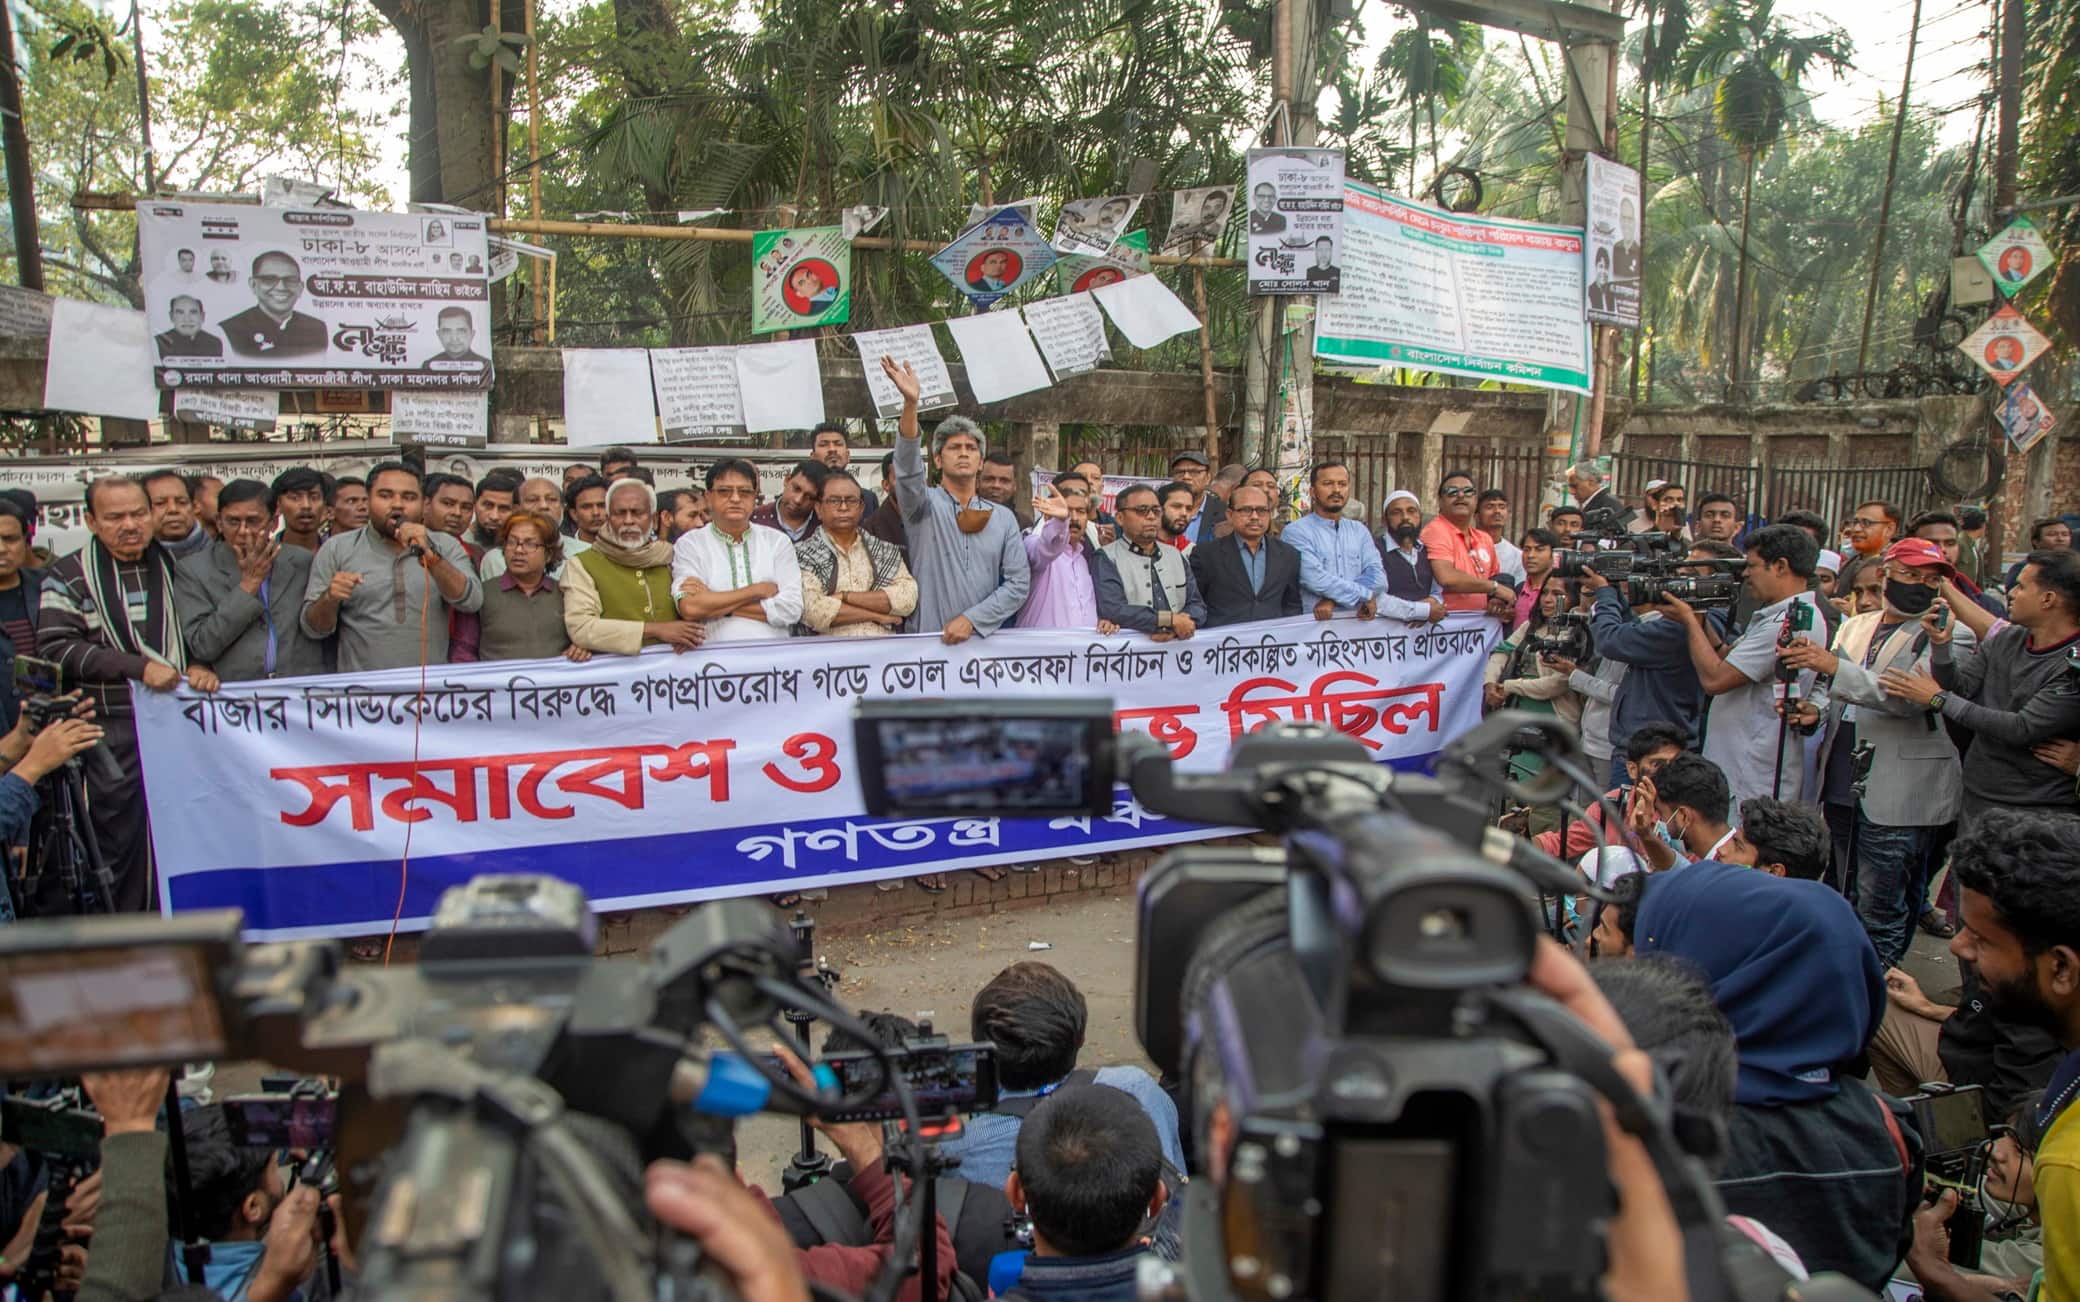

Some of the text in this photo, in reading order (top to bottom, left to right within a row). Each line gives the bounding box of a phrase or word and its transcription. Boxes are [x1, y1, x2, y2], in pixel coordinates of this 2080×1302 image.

[301, 238, 421, 258] ঢাকা-৮ আসনে
[364, 278, 418, 297] বাহাউদ্দিন
[420, 279, 451, 297] নাছিম
[454, 285, 483, 297] ভাইকে
[1407, 349, 1542, 377] বাংলাদেশ নির্বাচন কমিশন
[184, 371, 214, 385] রমনা
[217, 372, 241, 385] থানা
[244, 370, 292, 386] আওয়ামী
[380, 374, 404, 385] ঢাকা
[407, 374, 449, 386] মহানগর
[452, 373, 482, 386] দক্ষিণ
[177, 692, 291, 735] বাজার
[301, 680, 496, 732] সিন্ডিকেটের
[506, 675, 619, 721] বিরুদ্ধে
[631, 661, 802, 714] গণপ্রতিরোধ
[882, 656, 949, 694] তোল
[959, 649, 1078, 690] একতরফা
[1084, 640, 1169, 684] নির্বাচন
[1175, 650, 1194, 676] ও
[1203, 633, 1299, 676] পরিকল্পিত
[1303, 629, 1409, 670] সহিংসতার
[1413, 624, 1487, 662] প্রতিবাদে
[269, 737, 738, 832] সমাবেশ
[762, 731, 843, 795] ও
[735, 815, 1001, 870] গণতন্ত্র
